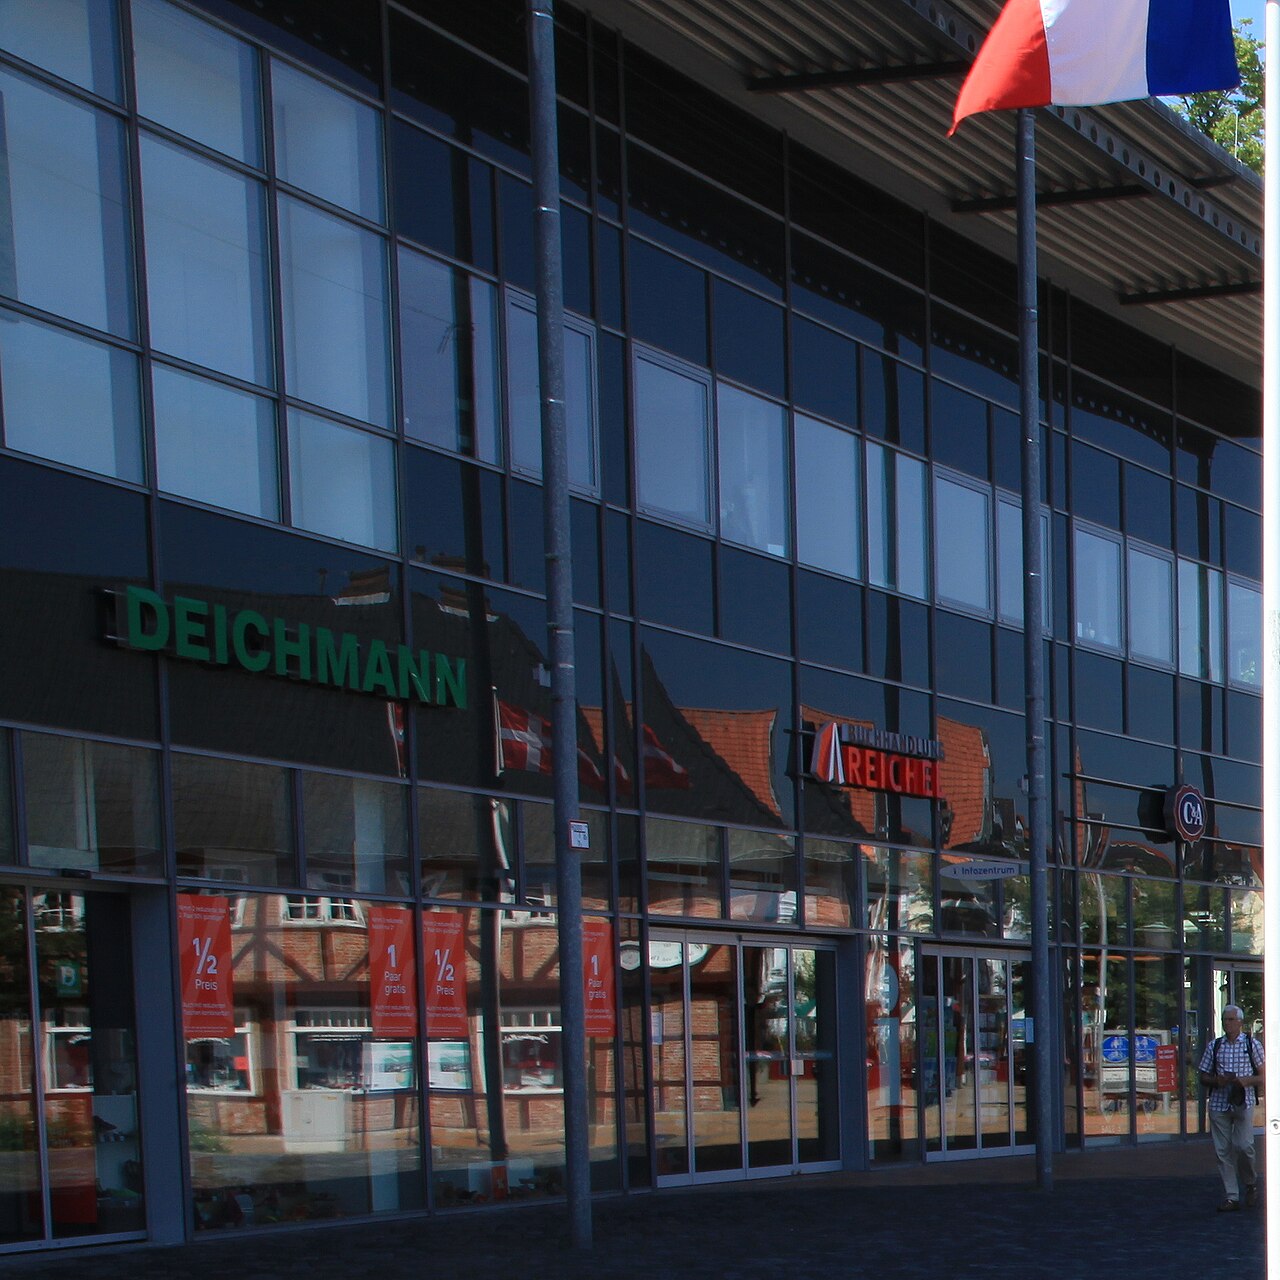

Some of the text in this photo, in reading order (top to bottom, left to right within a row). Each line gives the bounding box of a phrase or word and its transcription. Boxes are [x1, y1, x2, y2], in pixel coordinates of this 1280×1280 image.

[126, 585, 467, 709] DEICHMANN
[1183, 801, 1203, 826] C&A
[961, 866, 1015, 876] Infozentrum
[387, 944, 396, 968] 1
[591, 954, 599, 975] 1
[384, 971, 402, 982] Paar
[195, 979, 218, 991] Preis
[384, 984, 407, 996] gratis
[436, 985, 455, 996] Preis
